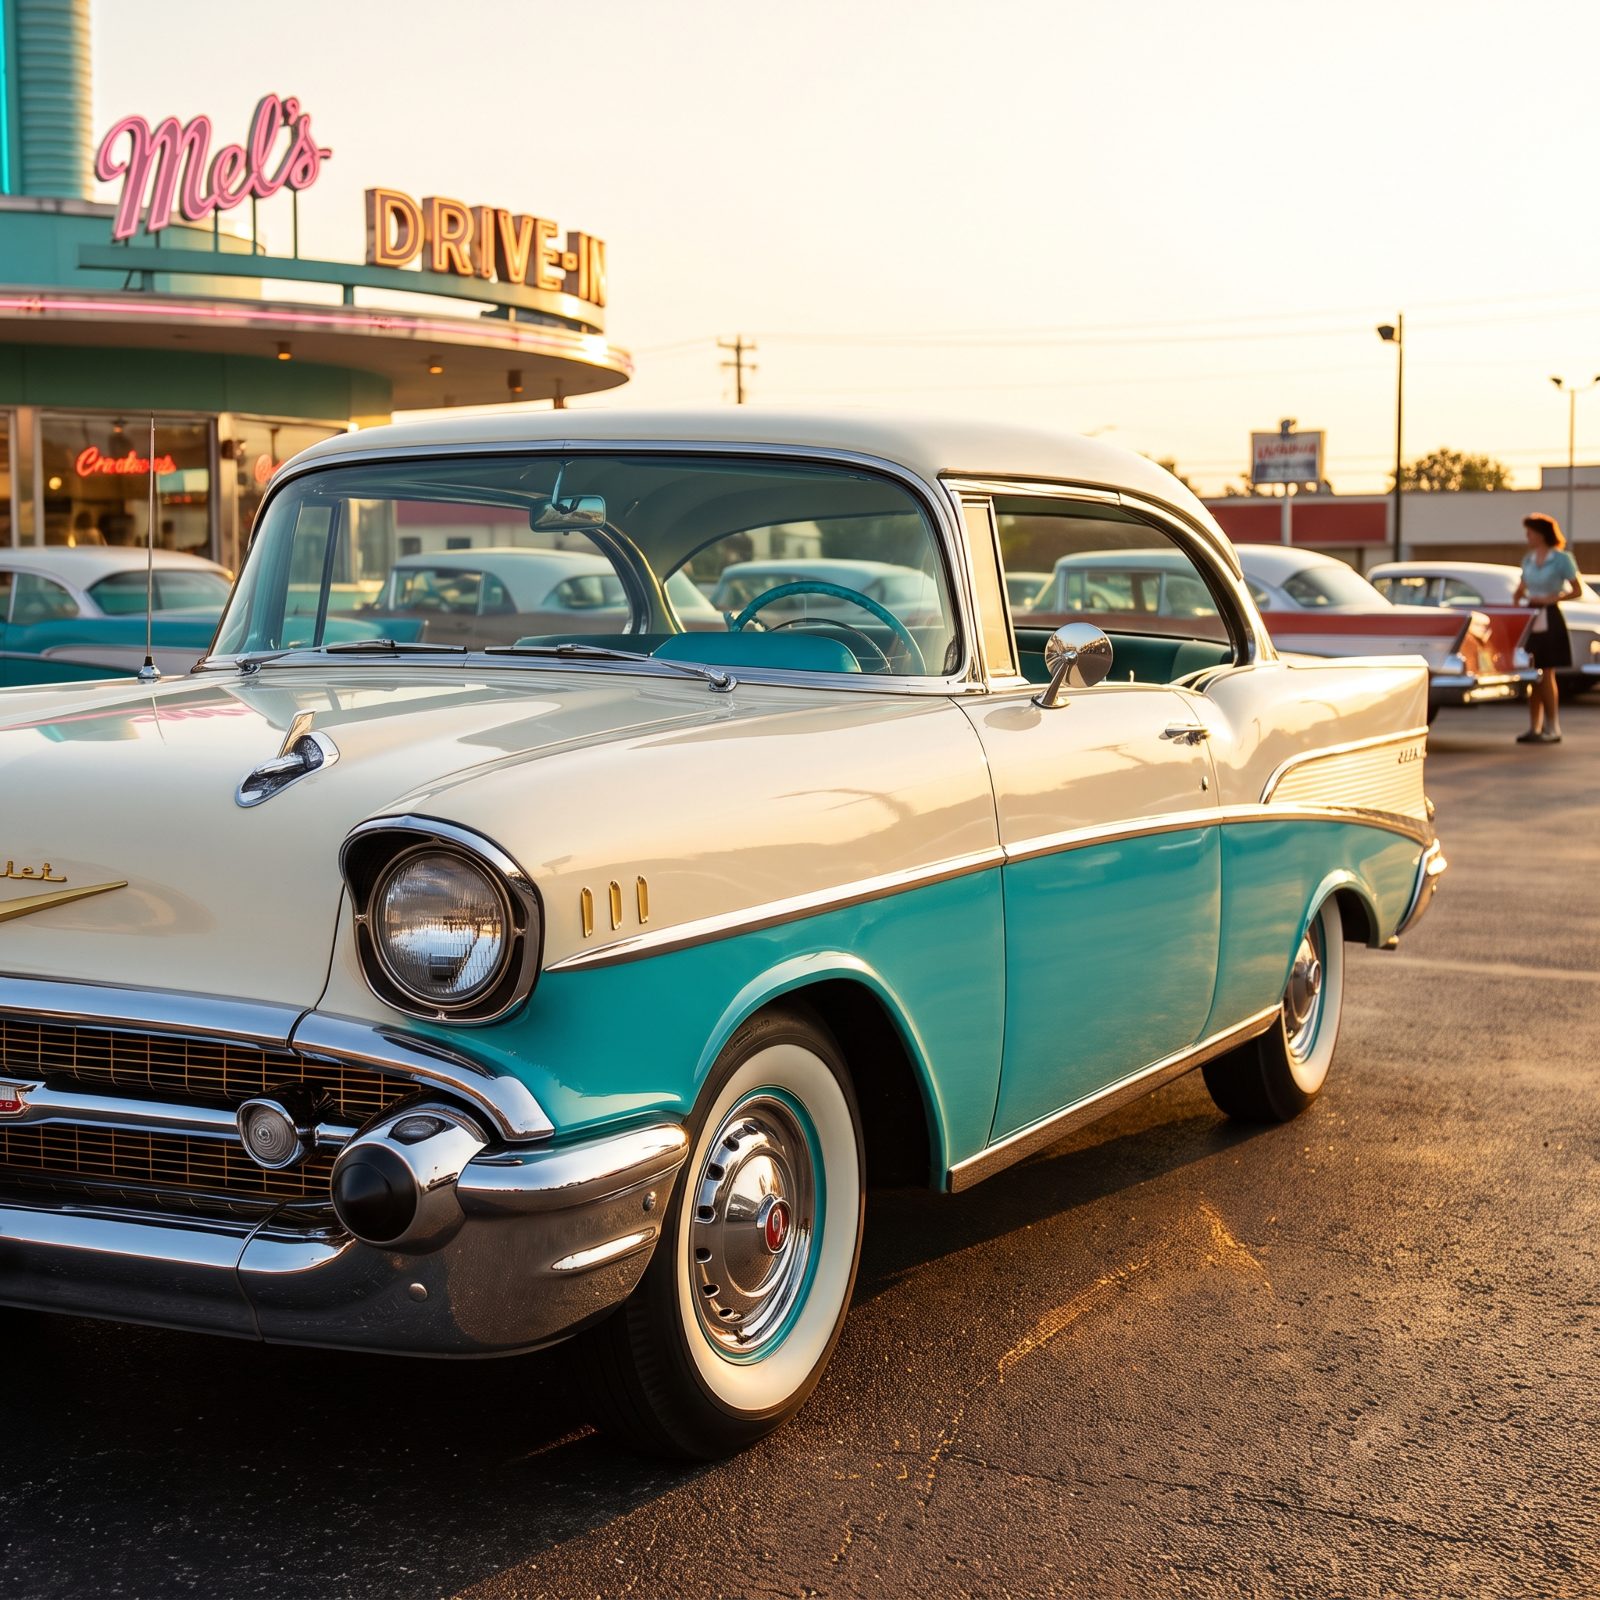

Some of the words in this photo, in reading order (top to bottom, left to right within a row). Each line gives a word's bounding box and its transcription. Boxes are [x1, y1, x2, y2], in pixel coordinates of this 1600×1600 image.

[95, 93, 332, 242] Mel's
[365, 188, 605, 307] DRIVE-IN
[0, 860, 67, 882] let
